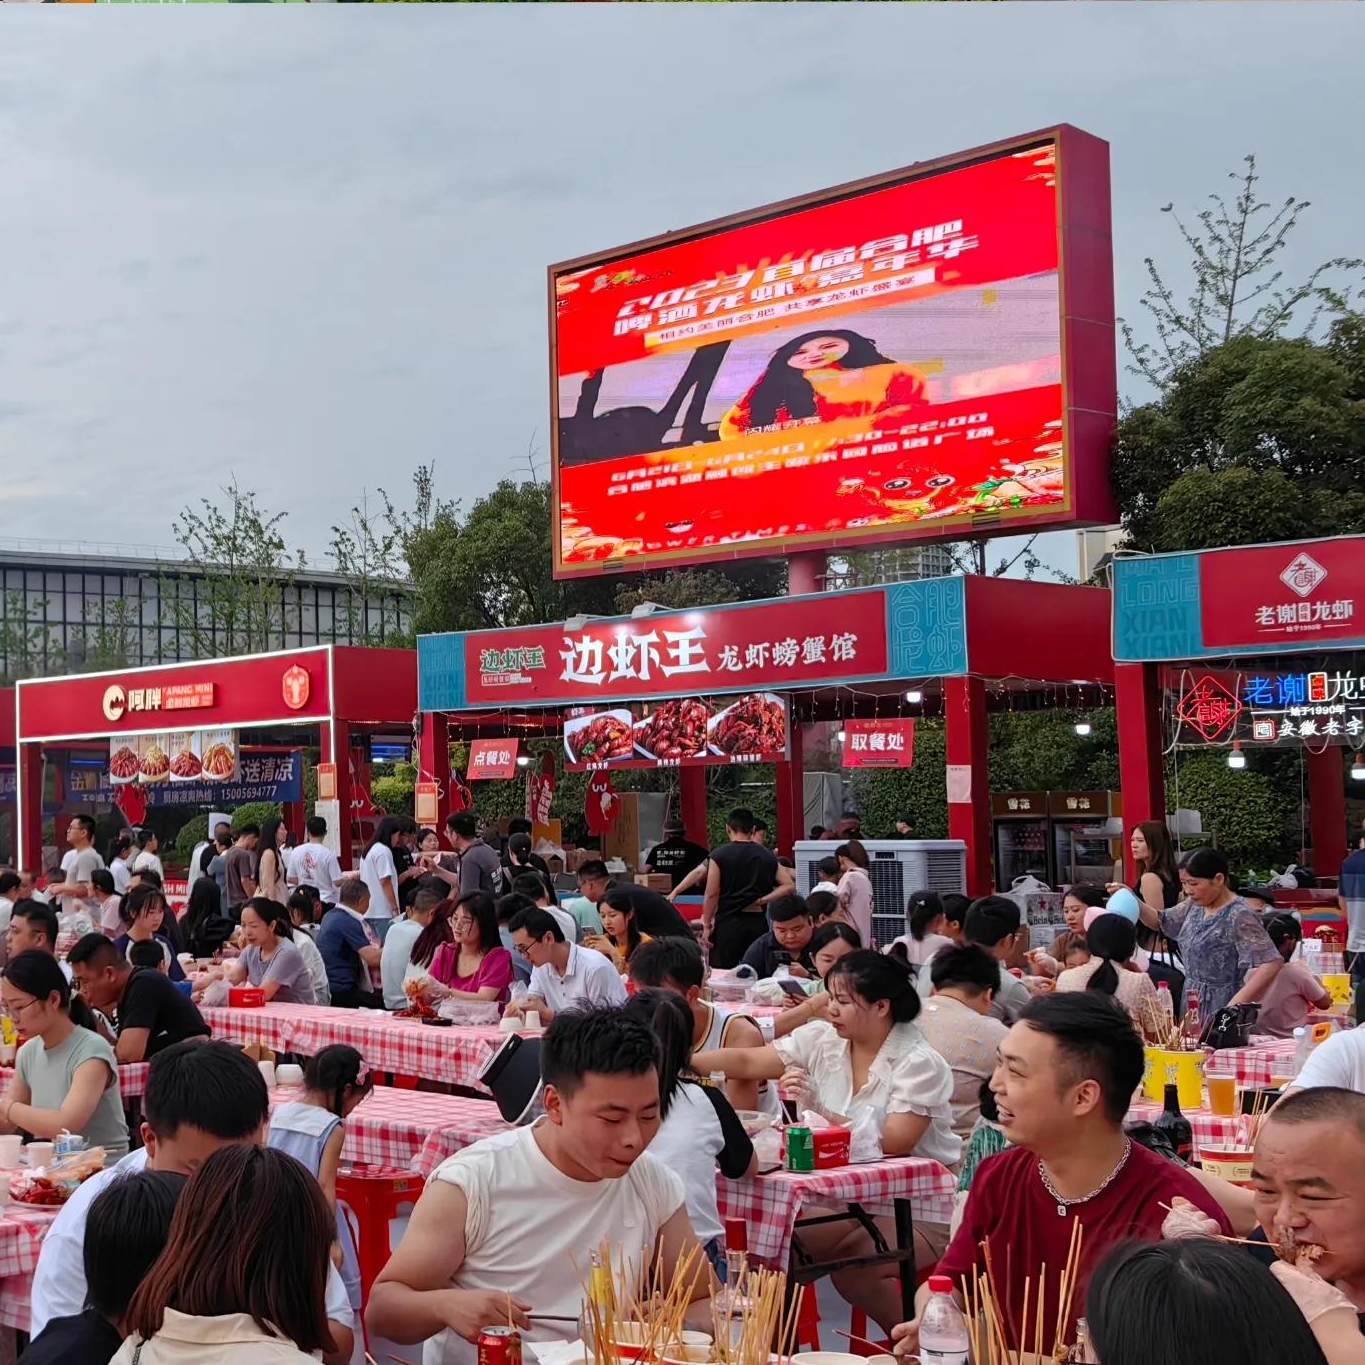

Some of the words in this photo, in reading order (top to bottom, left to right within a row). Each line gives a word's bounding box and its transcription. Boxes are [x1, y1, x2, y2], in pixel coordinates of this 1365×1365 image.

[616, 219, 963, 318] 2023首届合肥
[659, 307, 776, 342] 相约美丽合肥
[479, 645, 546, 674] 边虾王
[558, 625, 711, 686] 边虾王
[717, 631, 858, 671] 龙虾螃蟹馆
[128, 686, 162, 711] 阿胖
[1290, 704, 1346, 716] 始于1990年
[1278, 716, 1365, 736] 安徽老字
[851, 733, 904, 751] 取餐处
[473, 749, 511, 767] 点餐处
